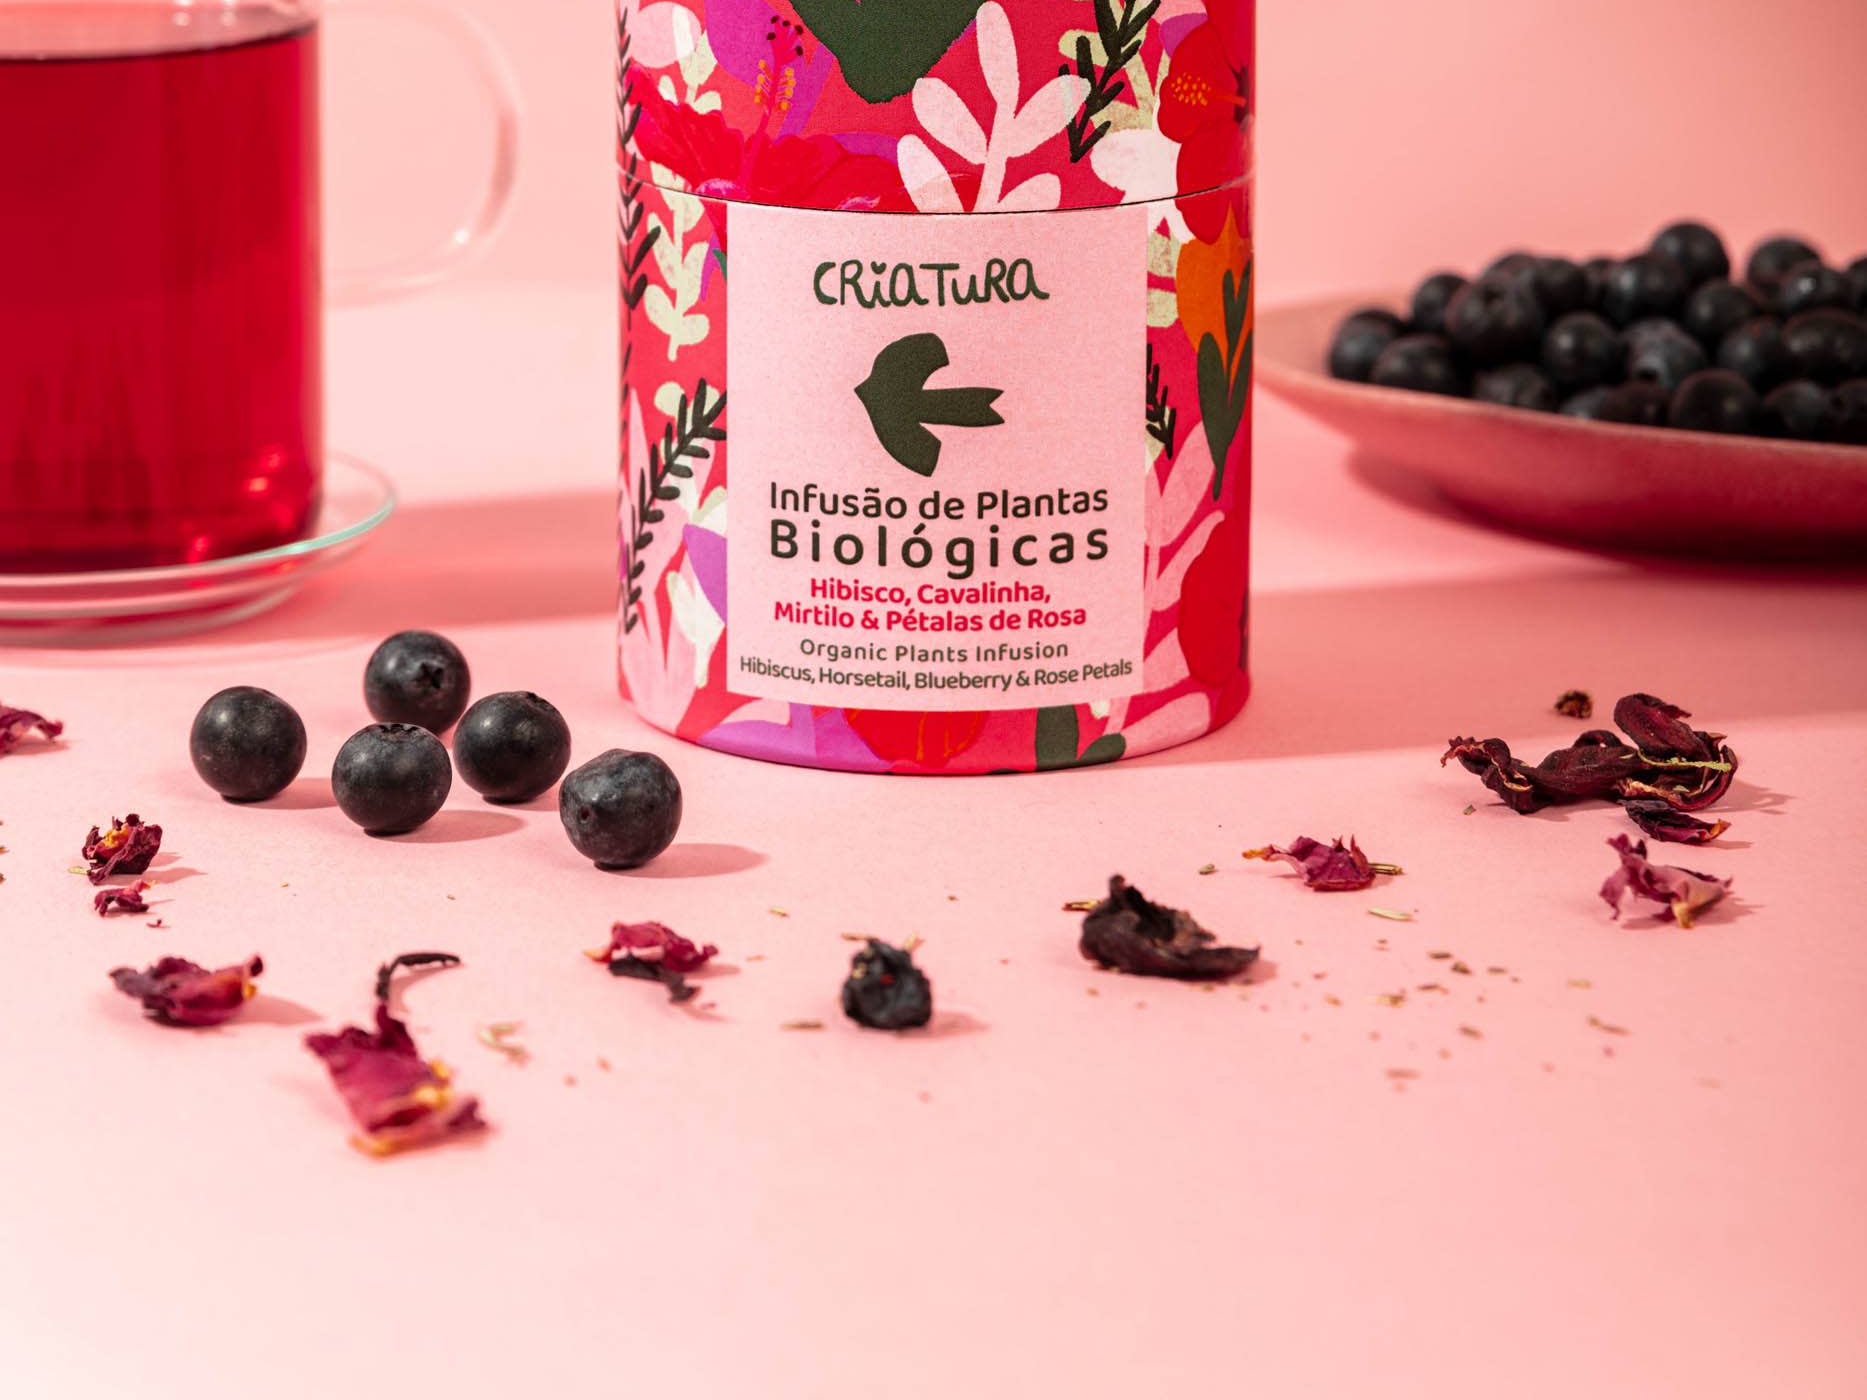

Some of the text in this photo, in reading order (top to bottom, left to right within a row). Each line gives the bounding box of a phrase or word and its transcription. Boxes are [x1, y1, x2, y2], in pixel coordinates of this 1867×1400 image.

[770, 481, 1109, 521] Infusão de Plantas
[770, 518, 1109, 581] Biológicas
[810, 576, 1052, 608] Hibisco, Cavalinha,
[774, 600, 1087, 633] Mirtilo & Pétalas de Rosa
[800, 638, 1069, 663] Organic Plants Infusion
[740, 656, 1133, 693] Hibiscus, Horsetail, Blueberry & Rose Petals
